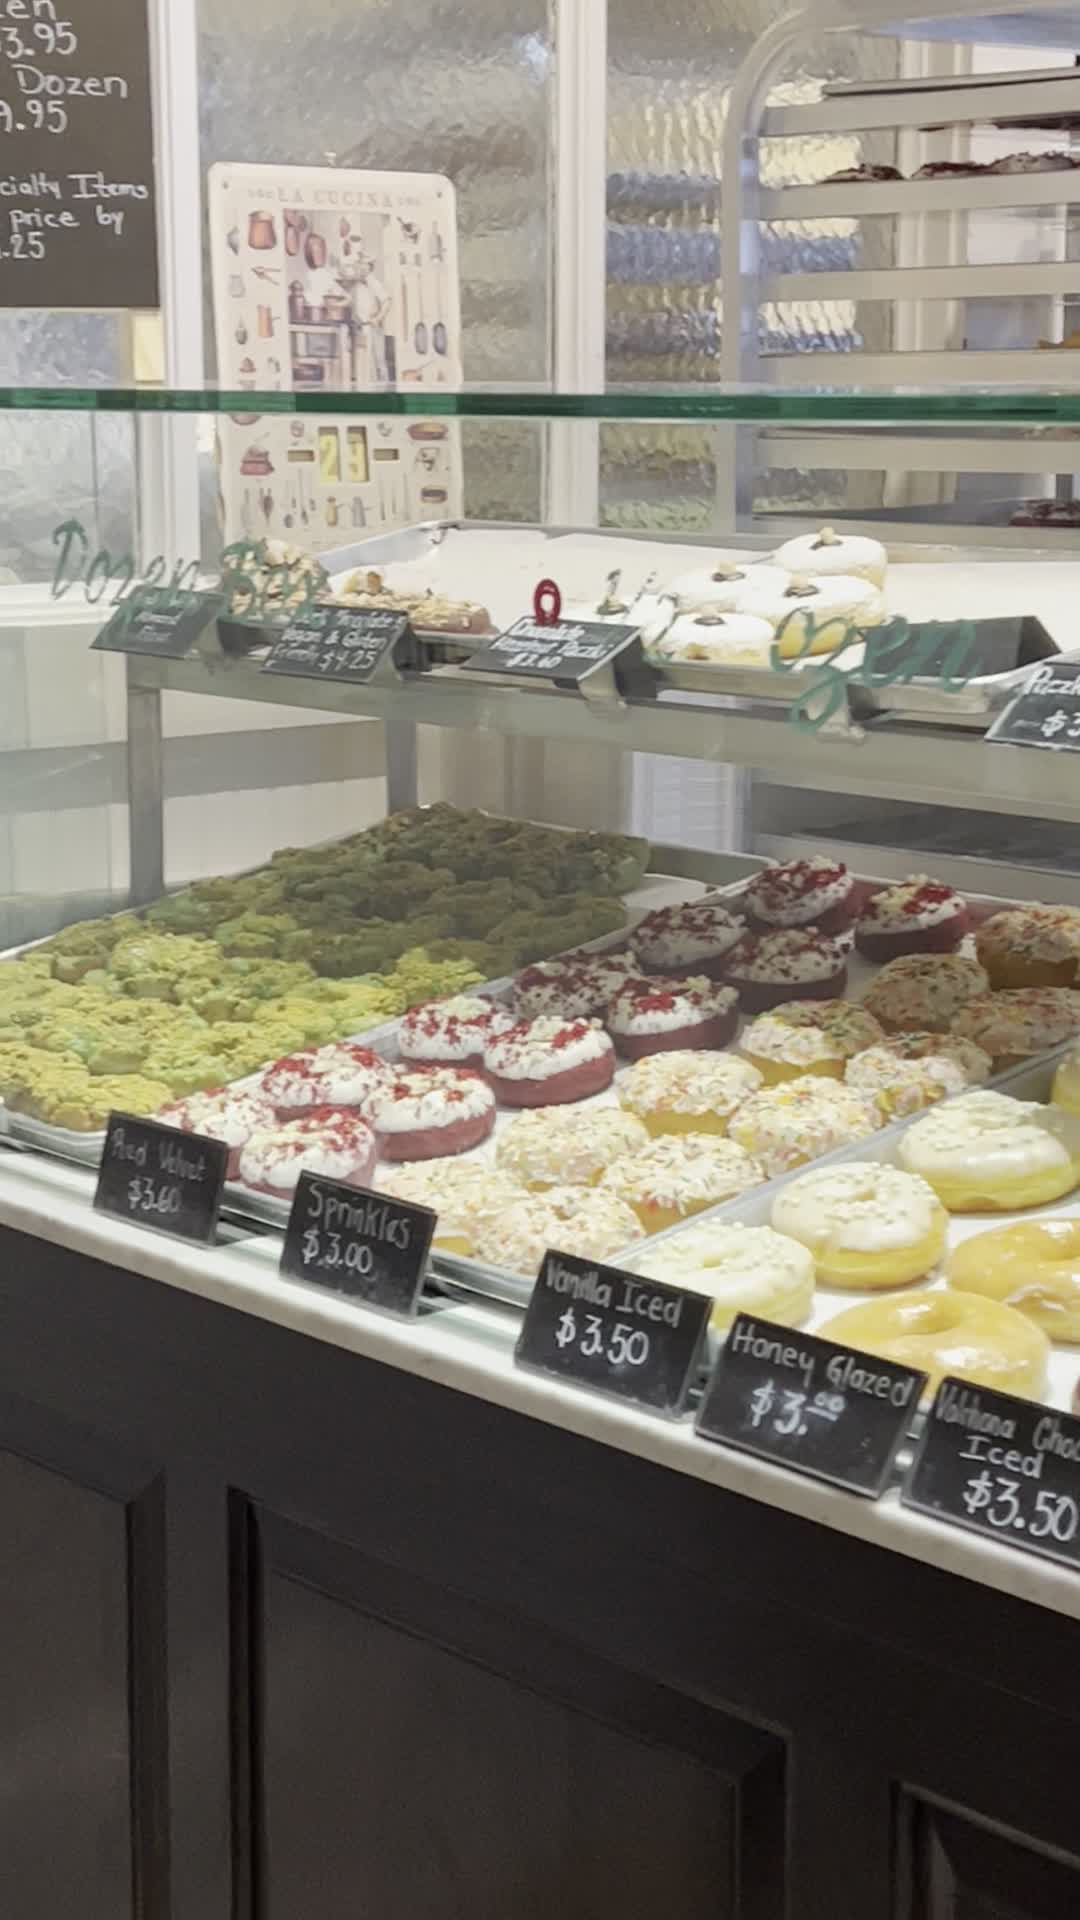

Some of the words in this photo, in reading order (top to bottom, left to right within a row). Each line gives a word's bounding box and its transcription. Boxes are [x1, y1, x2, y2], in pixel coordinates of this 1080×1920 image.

[11, 64, 128, 99] Dozen
[67, 170, 149, 199] Items
[9, 207, 80, 233] price
[96, 204, 124, 235] by
[307, 1182, 411, 1249] Sprinkles
[546, 1258, 613, 1309] Vanilla
[615, 1280, 685, 1329] Iced
[555, 1306, 650, 1365] $3.50
[731, 1321, 815, 1389] Honey
[826, 1354, 915, 1408] Glazed
[958, 1434, 1044, 1479] Iced
[962, 1470, 1079, 1542] $3.50
